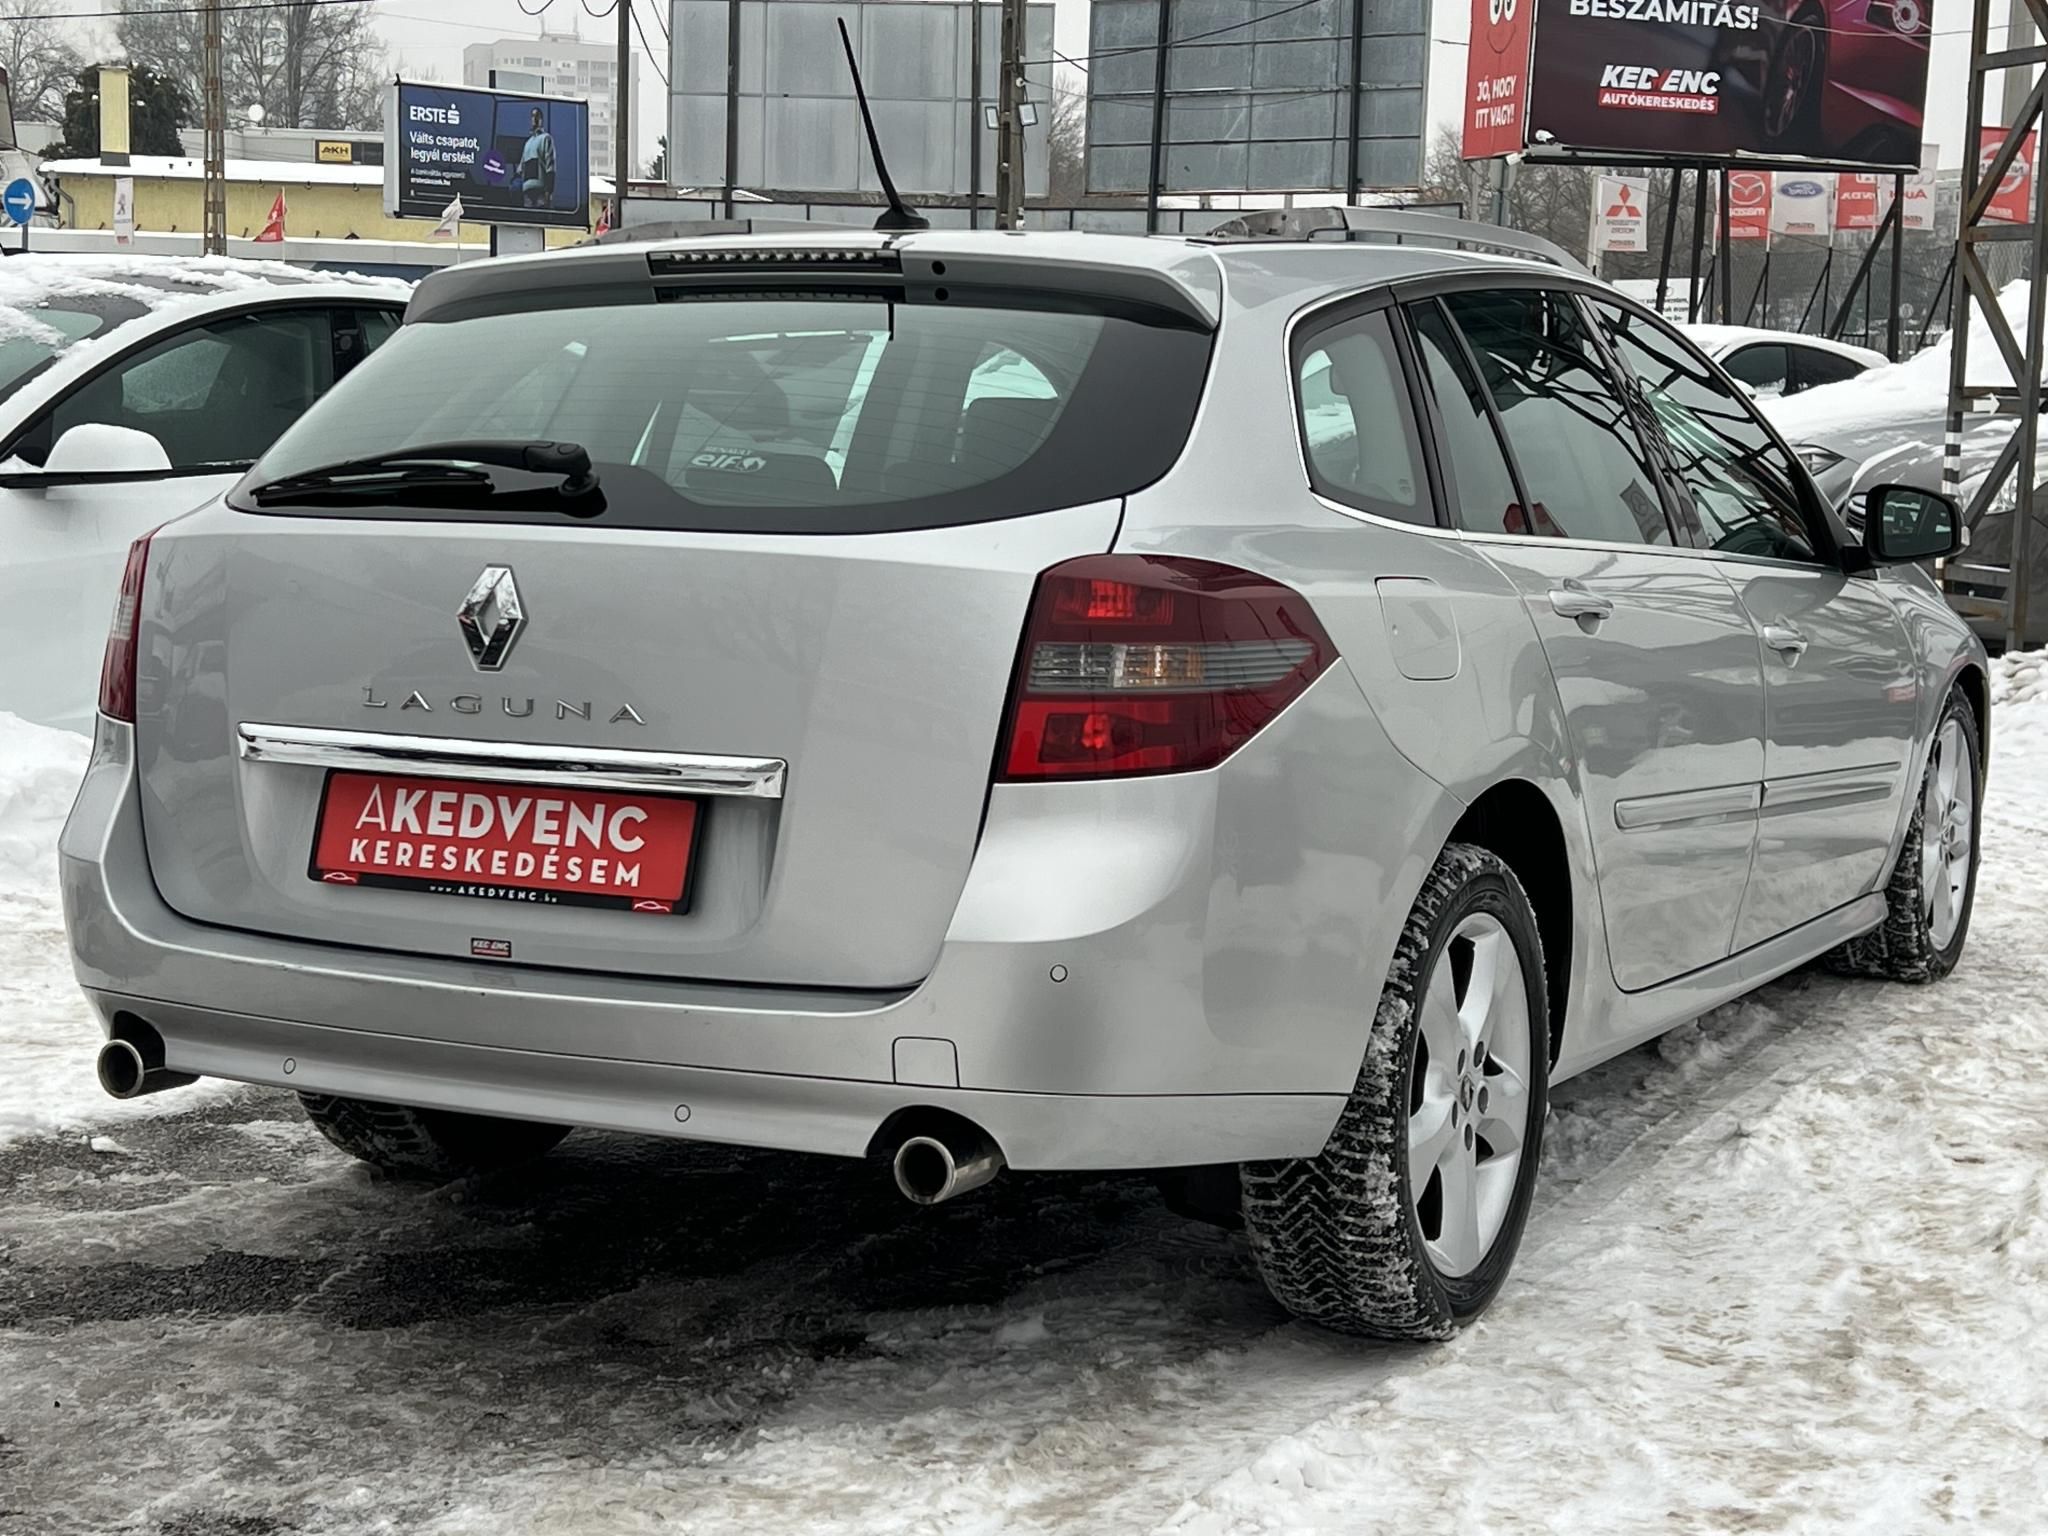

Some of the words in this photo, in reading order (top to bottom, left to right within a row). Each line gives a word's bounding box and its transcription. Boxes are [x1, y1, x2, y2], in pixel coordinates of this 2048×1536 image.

[1476, 75, 1491, 104] JÓ,
[1492, 75, 1517, 99] HOGY
[1601, 92, 1716, 111] AUTÓKERESKEDÉS
[410, 105, 447, 123] ERSTE
[1475, 108, 1490, 129] ITT
[1490, 103, 1515, 127] VAGY!
[409, 131, 435, 145] Válts
[436, 135, 480, 152] csapatot,
[410, 147, 440, 163] legyél
[442, 151, 475, 164] erstés!
[362, 685, 648, 726] LAGUNA
[349, 838, 642, 888] KERESKEDÉSEM
